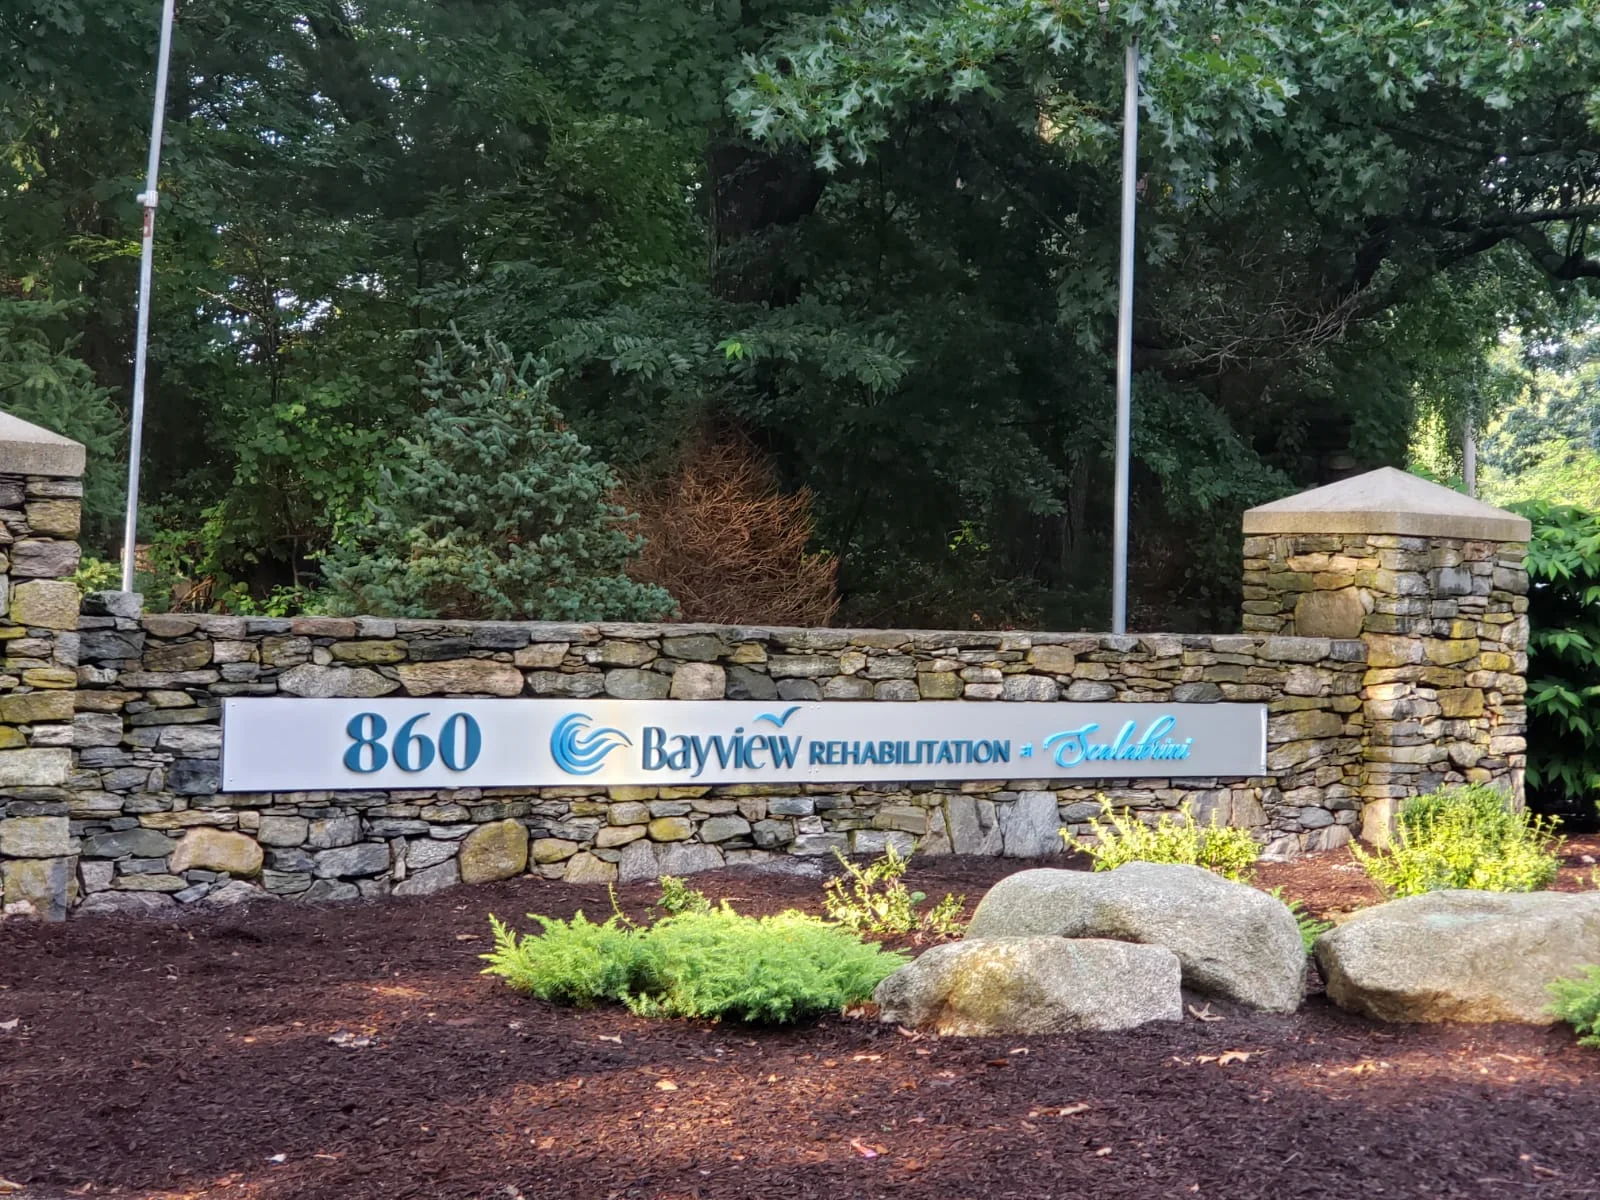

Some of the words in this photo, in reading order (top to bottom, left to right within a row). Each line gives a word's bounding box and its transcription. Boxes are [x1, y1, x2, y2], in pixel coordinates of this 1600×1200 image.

[343, 712, 481, 773] 860
[642, 726, 802, 777] Bayview
[809, 740, 1010, 765] REHABILITATION
